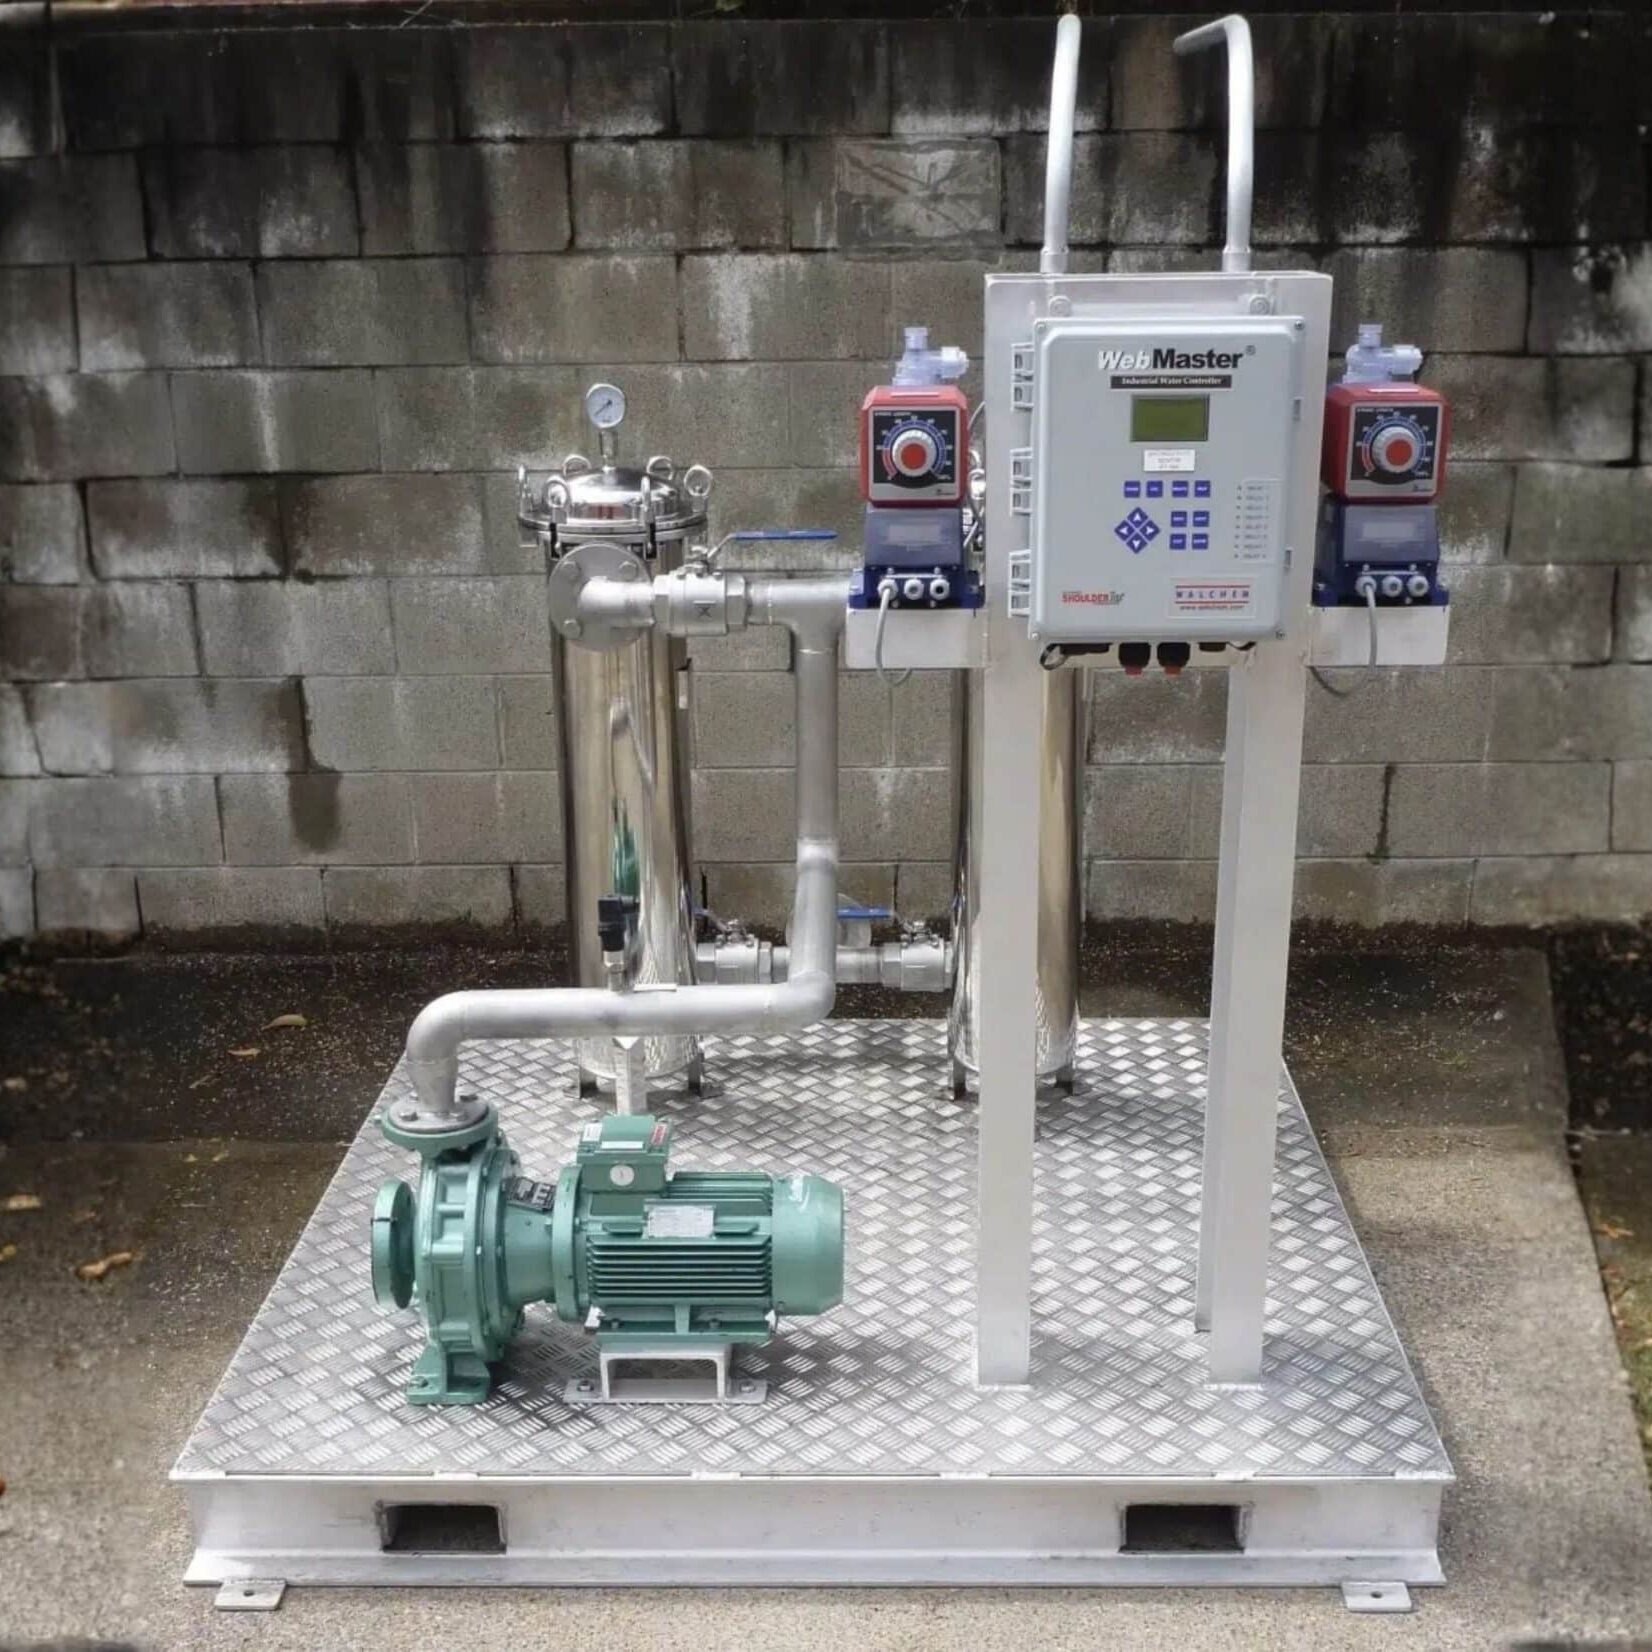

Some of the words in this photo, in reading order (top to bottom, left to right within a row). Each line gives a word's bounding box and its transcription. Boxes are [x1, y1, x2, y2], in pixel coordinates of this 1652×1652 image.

[1096, 347, 1244, 368] WebMaster
[1122, 376, 1158, 385] Industrial
[1160, 376, 1183, 385] Water
[1184, 376, 1222, 385] Controller
